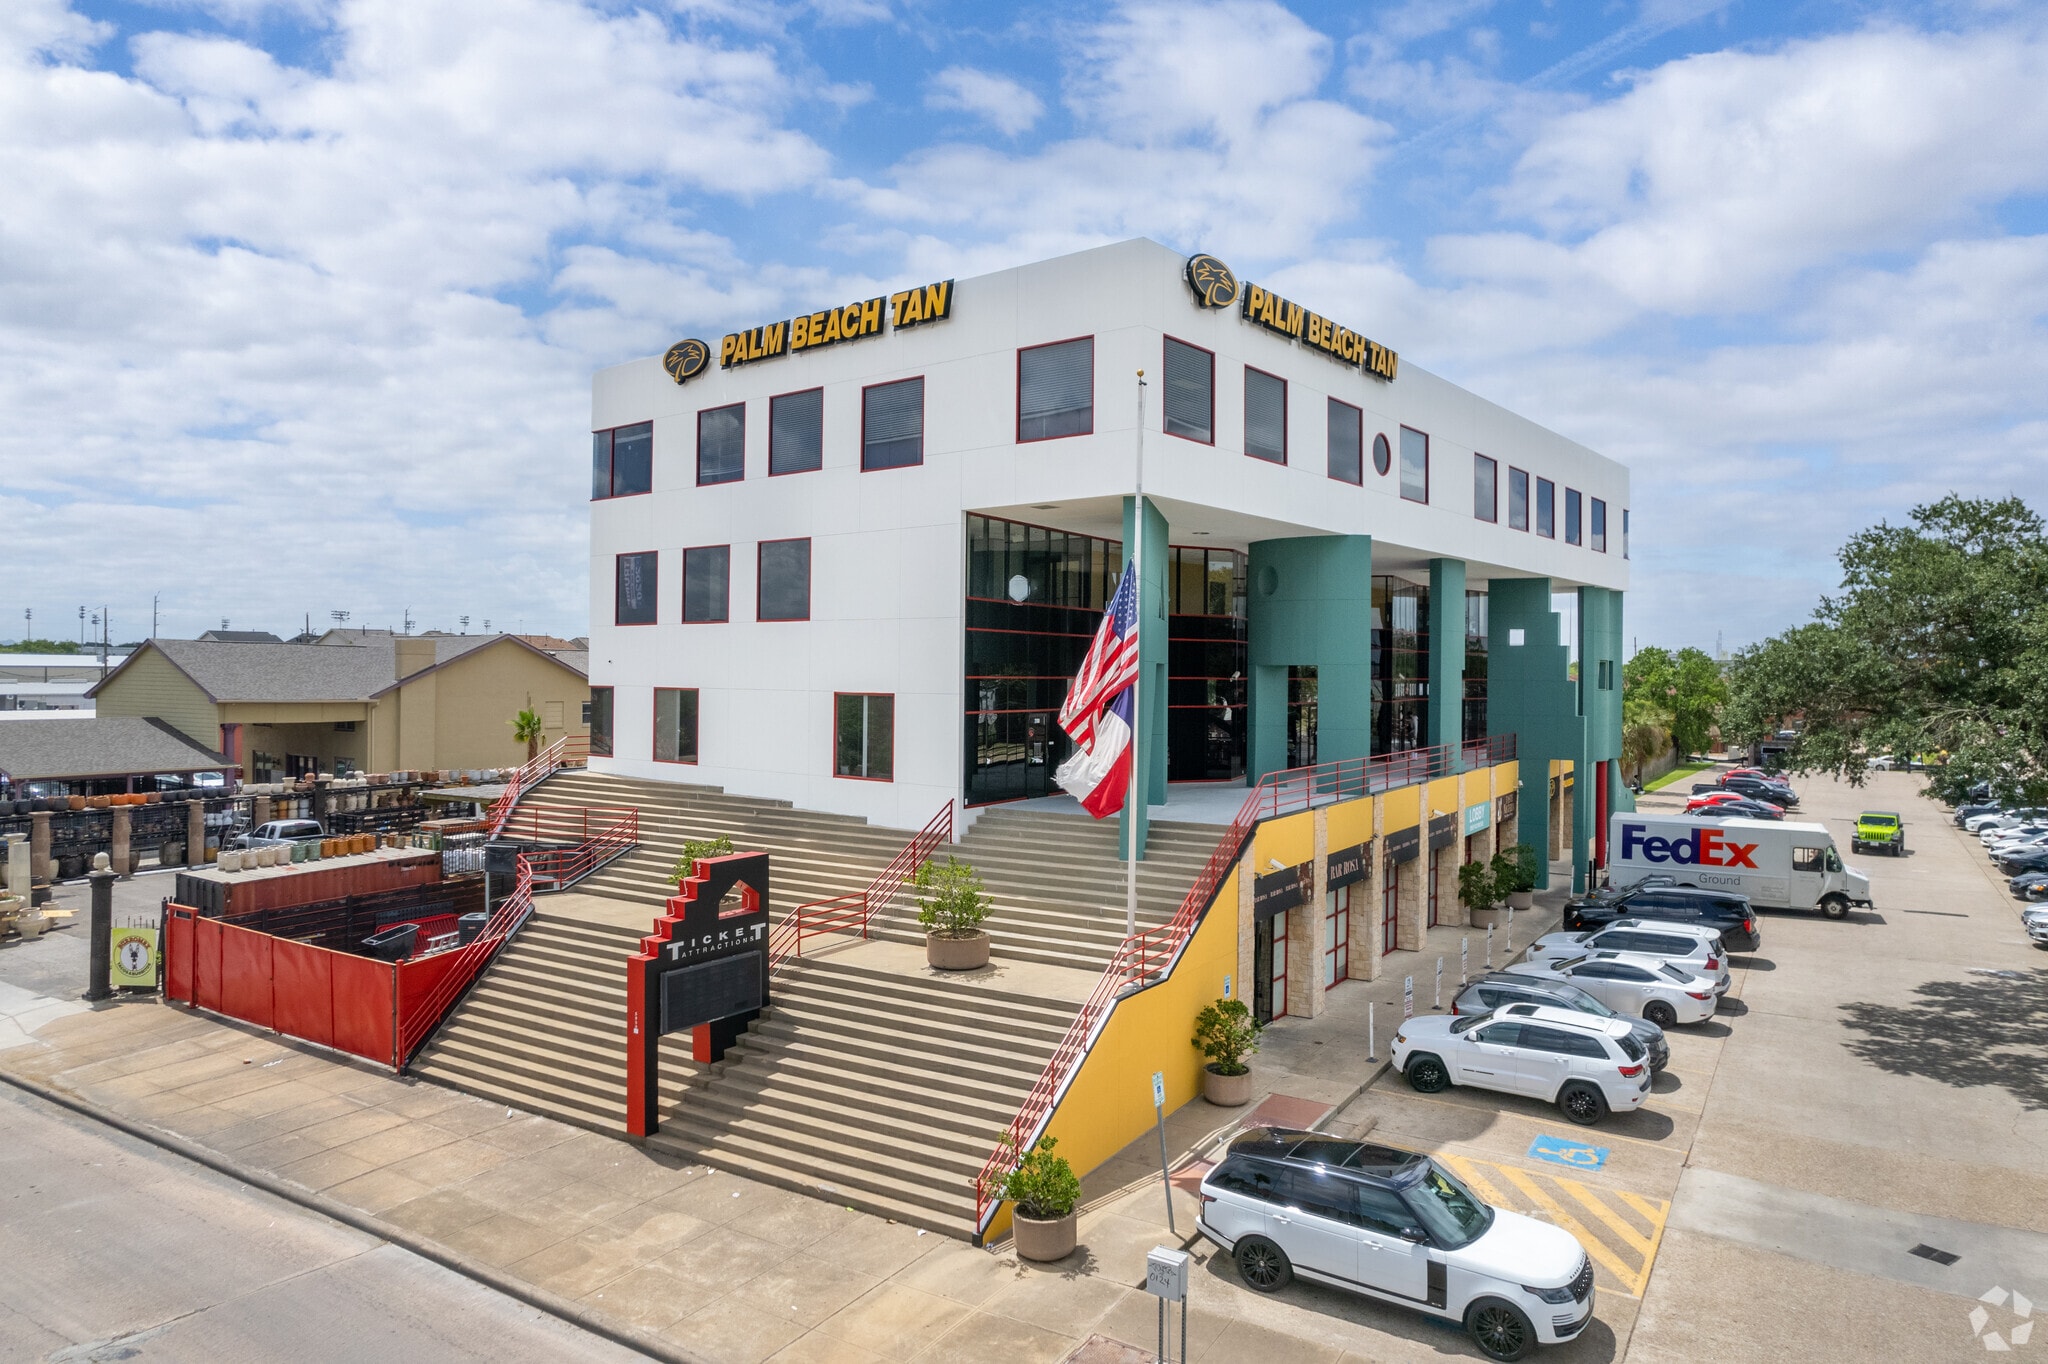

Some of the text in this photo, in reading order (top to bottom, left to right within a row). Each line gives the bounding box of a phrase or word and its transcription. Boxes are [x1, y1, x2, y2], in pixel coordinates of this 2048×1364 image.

[720, 280, 952, 368] PALM BEACH TAN
[1246, 283, 1399, 380] PALM BEACH TAN
[1469, 805, 1485, 823] LOBBY
[1621, 824, 1759, 869] FedEx
[1698, 872, 1741, 886] Ground
[666, 922, 767, 961] TICKET
[680, 935, 755, 959] ATTRACTIONS
[1149, 1272, 1170, 1289] 0124
